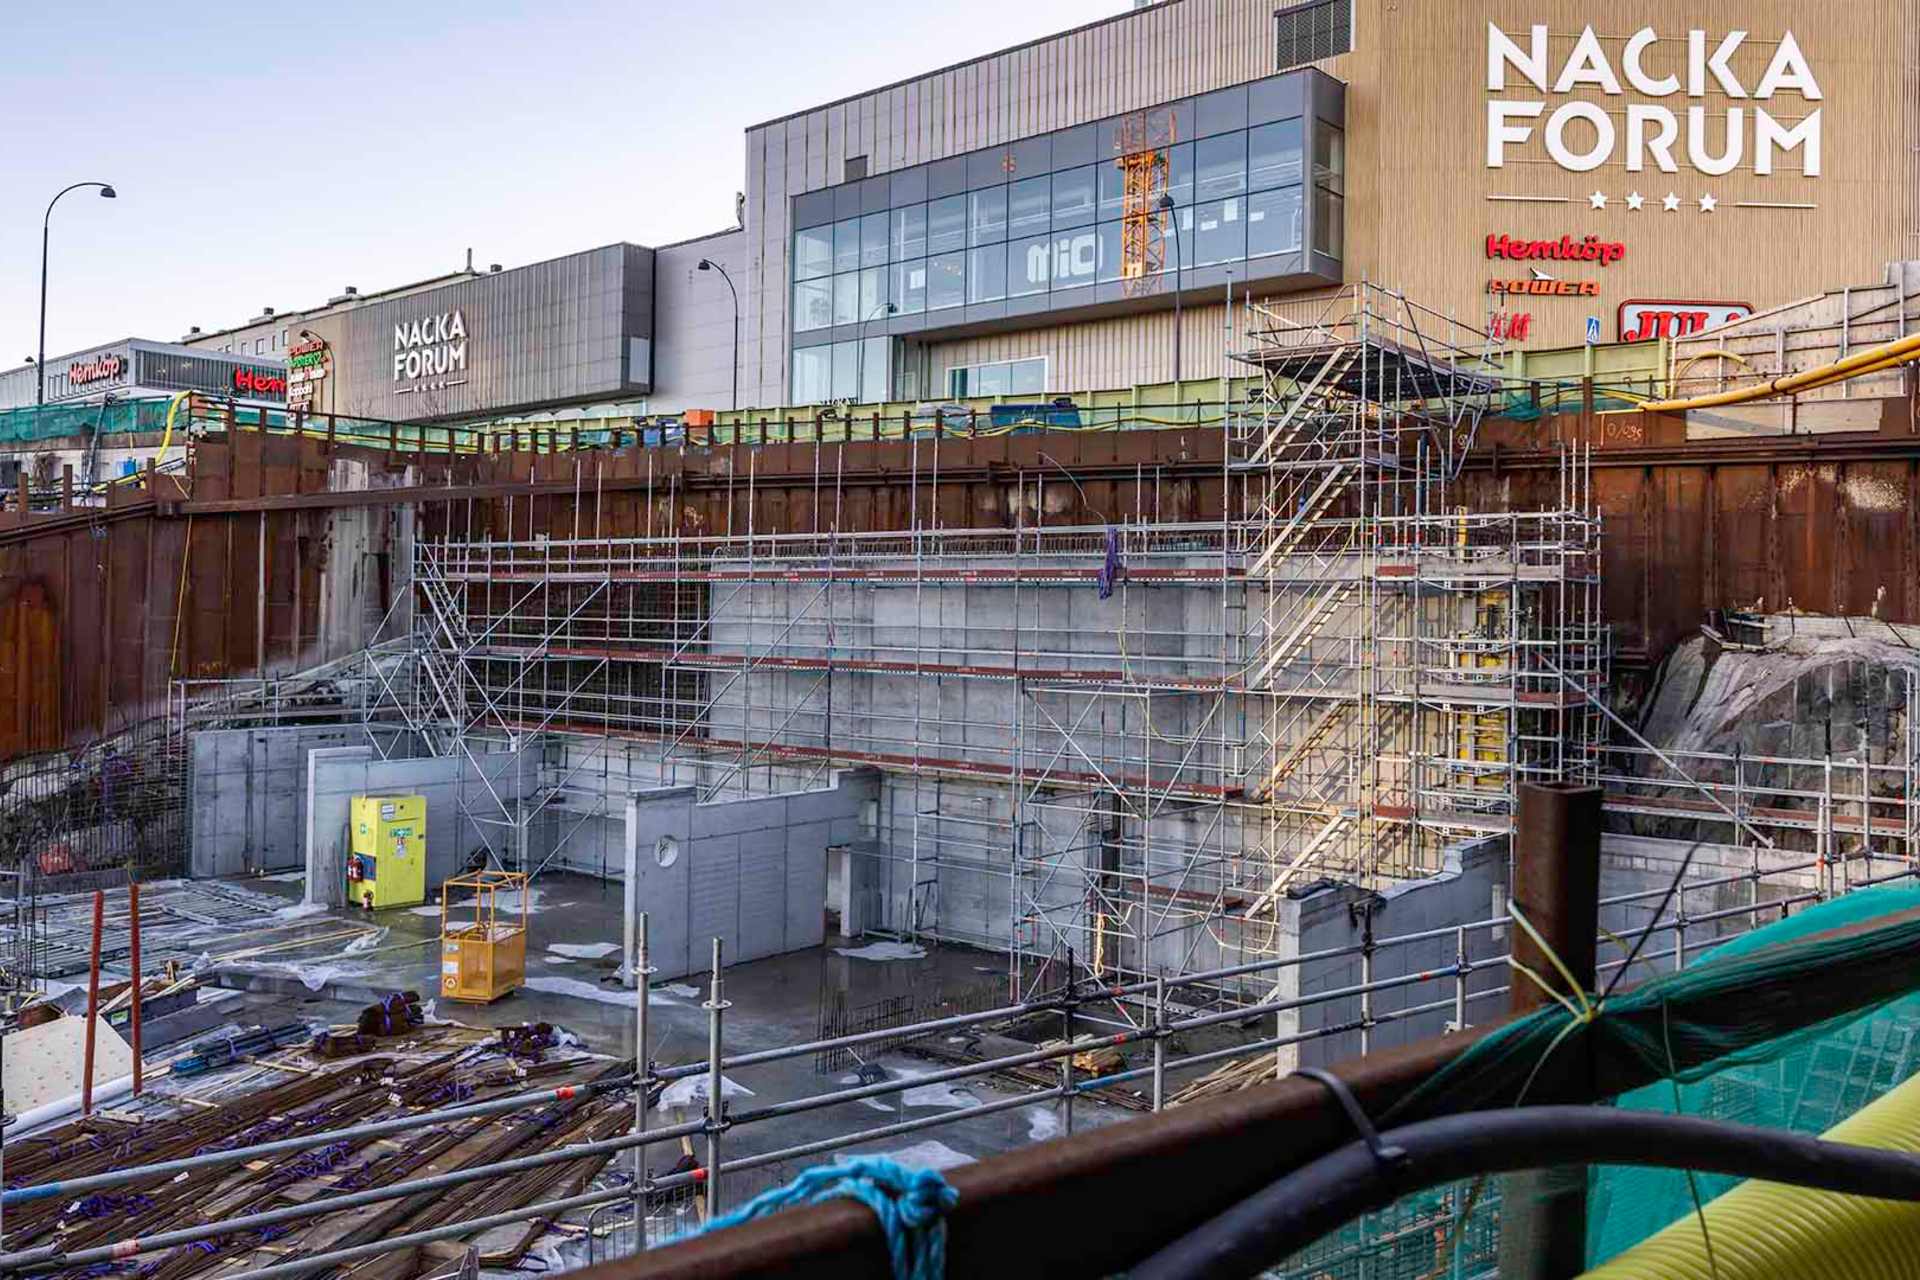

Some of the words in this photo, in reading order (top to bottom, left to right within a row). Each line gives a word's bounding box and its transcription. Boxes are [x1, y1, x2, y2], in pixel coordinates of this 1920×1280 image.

[1487, 21, 1823, 99] NACKA
[1487, 100, 1822, 176] FORUM
[1486, 233, 1625, 266] Hemköp
[394, 310, 468, 351] NACKA
[394, 341, 467, 381] FORUM
